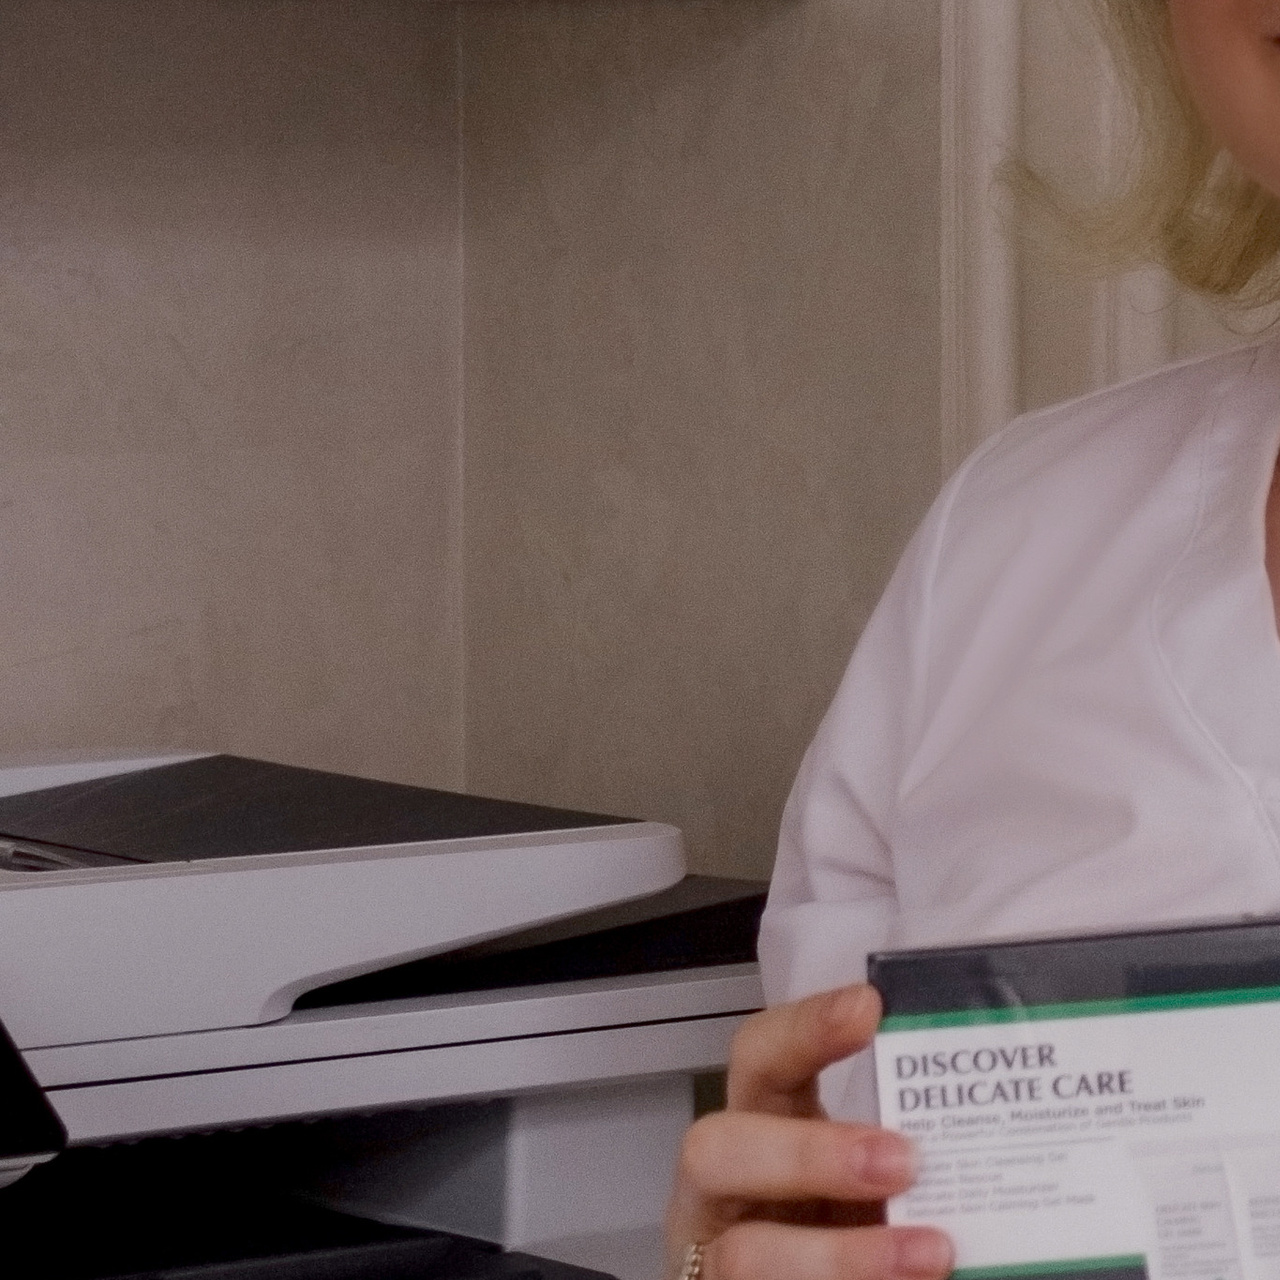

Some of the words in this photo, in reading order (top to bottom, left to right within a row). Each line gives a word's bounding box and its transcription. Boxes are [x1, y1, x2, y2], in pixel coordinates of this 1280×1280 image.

[895, 1043, 1057, 1080] DISCOVER
[899, 1077, 1043, 1113] DELICATE
[1051, 1070, 1135, 1101] CARE
[900, 1118, 935, 1132] Help
[940, 1113, 1006, 1129] Cleanse,
[1010, 1105, 1089, 1121] Moisturize
[1094, 1102, 1124, 1116] and
[1129, 1098, 1167, 1113] Treat
[1173, 1095, 1206, 1109] Skin
